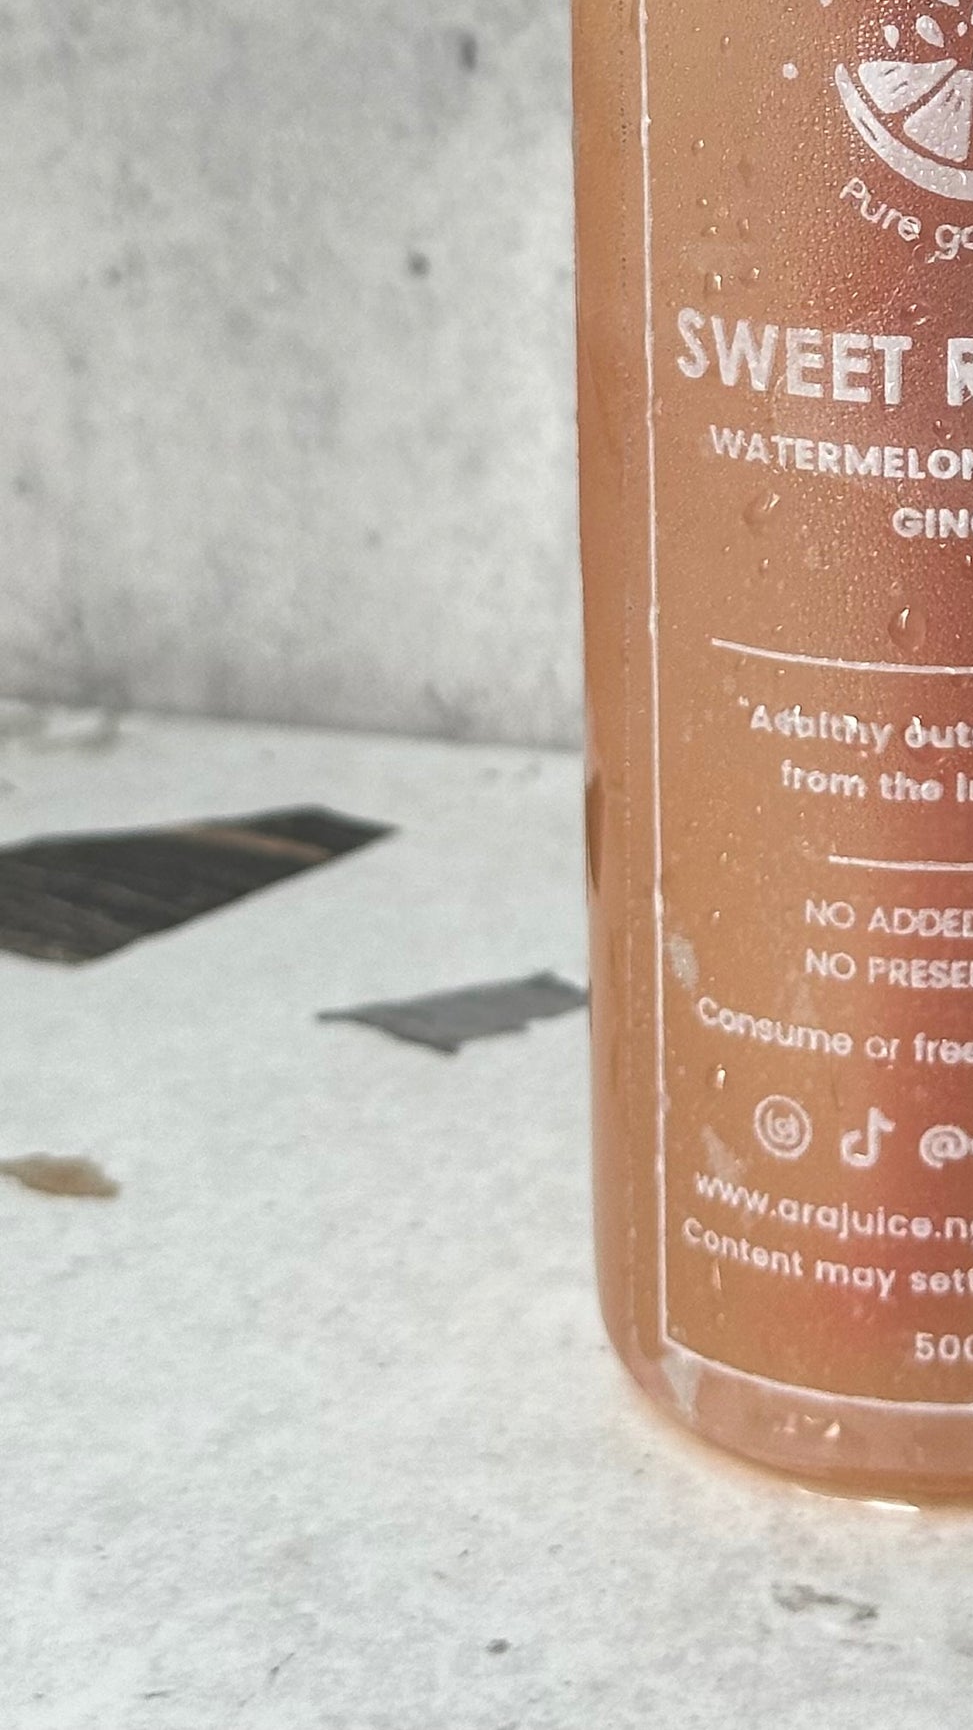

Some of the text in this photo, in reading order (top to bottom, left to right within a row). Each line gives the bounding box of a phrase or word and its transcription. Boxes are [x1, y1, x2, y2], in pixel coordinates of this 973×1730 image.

[839, 176, 923, 242] Pure
[676, 307, 912, 406] SWEET
[781, 758, 866, 799] from
[880, 770, 945, 803] the
[804, 898, 855, 931] NO
[804, 948, 856, 982] NO
[698, 995, 853, 1057] Consume
[865, 1033, 898, 1059] or
[681, 1216, 804, 1277] Content
[815, 1259, 897, 1301] may
